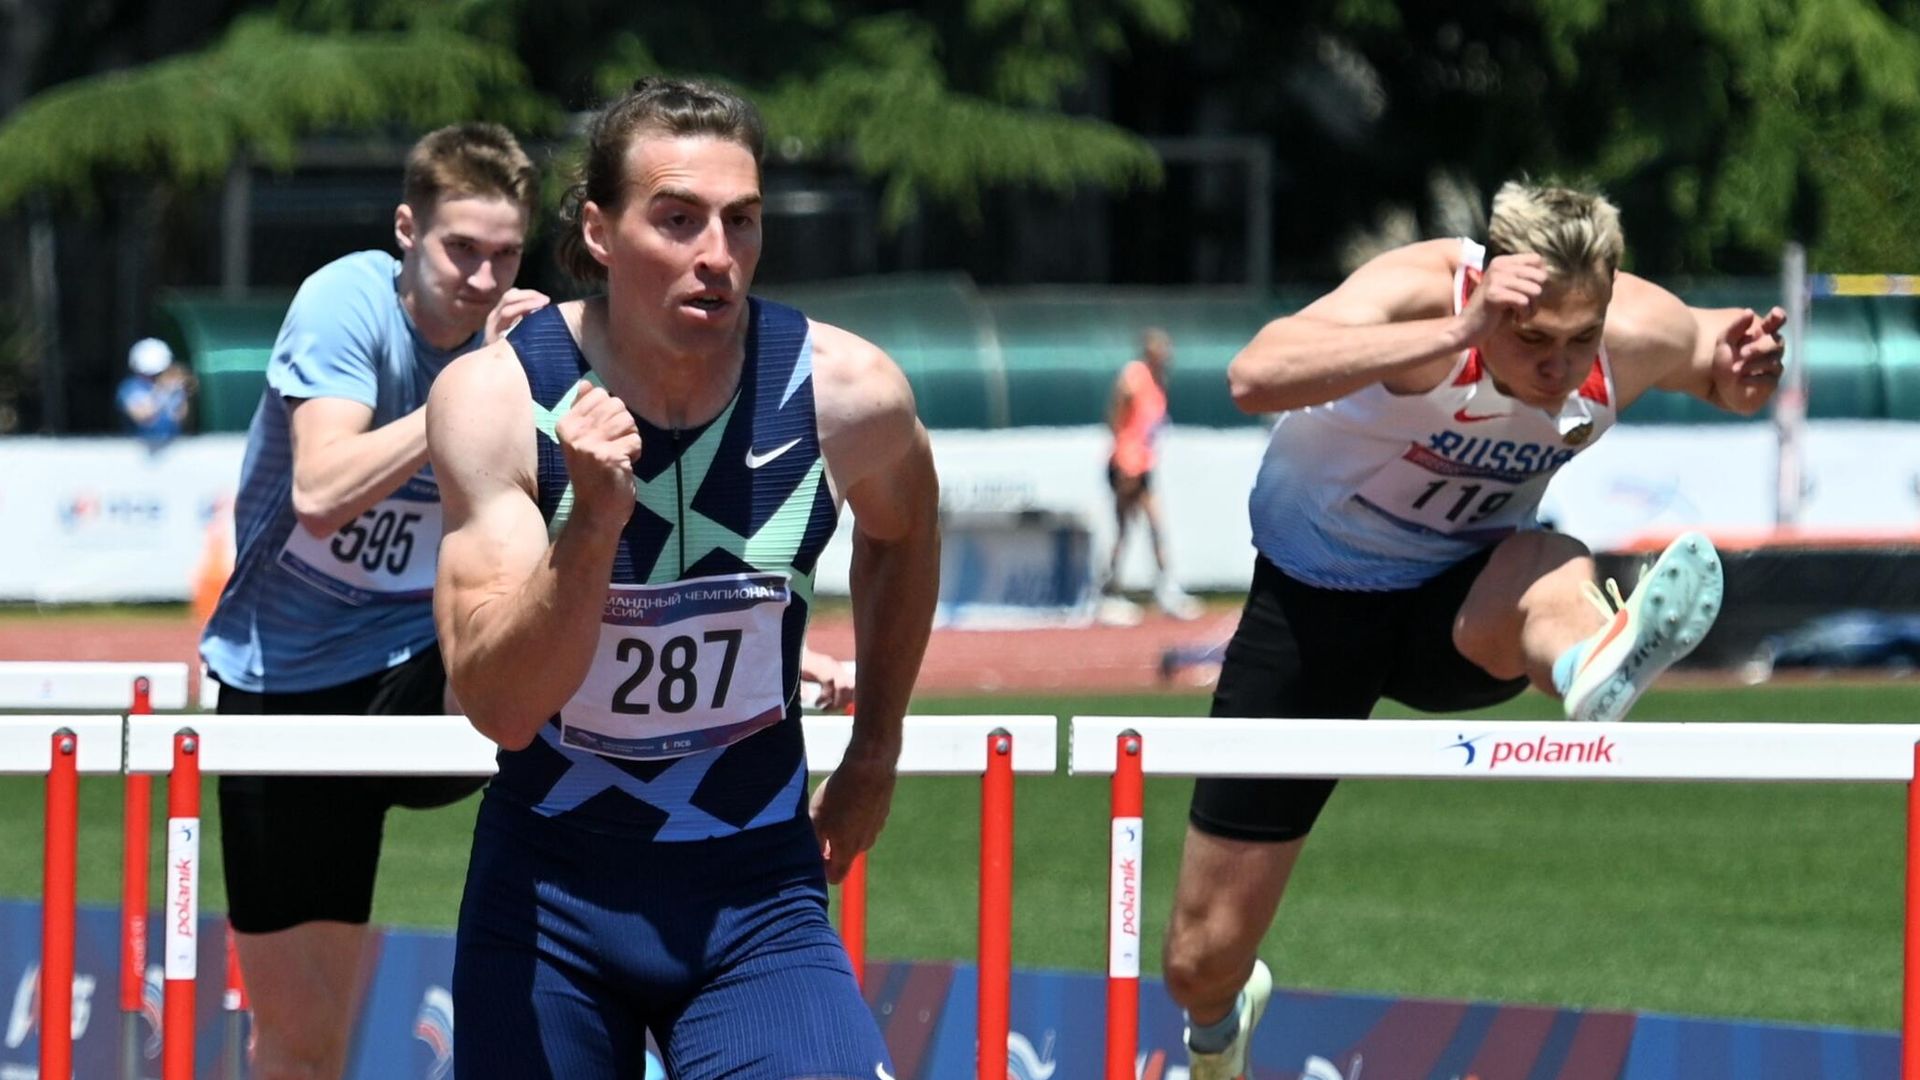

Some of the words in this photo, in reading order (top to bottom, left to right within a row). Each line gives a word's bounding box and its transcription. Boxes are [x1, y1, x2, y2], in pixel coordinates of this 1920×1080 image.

[1412, 480, 1514, 523] 119
[330, 509, 423, 577] 595
[611, 629, 743, 715] 287
[1489, 735, 1616, 769] polanik
[175, 858, 193, 938] polanik
[1119, 858, 1138, 936] polanik
